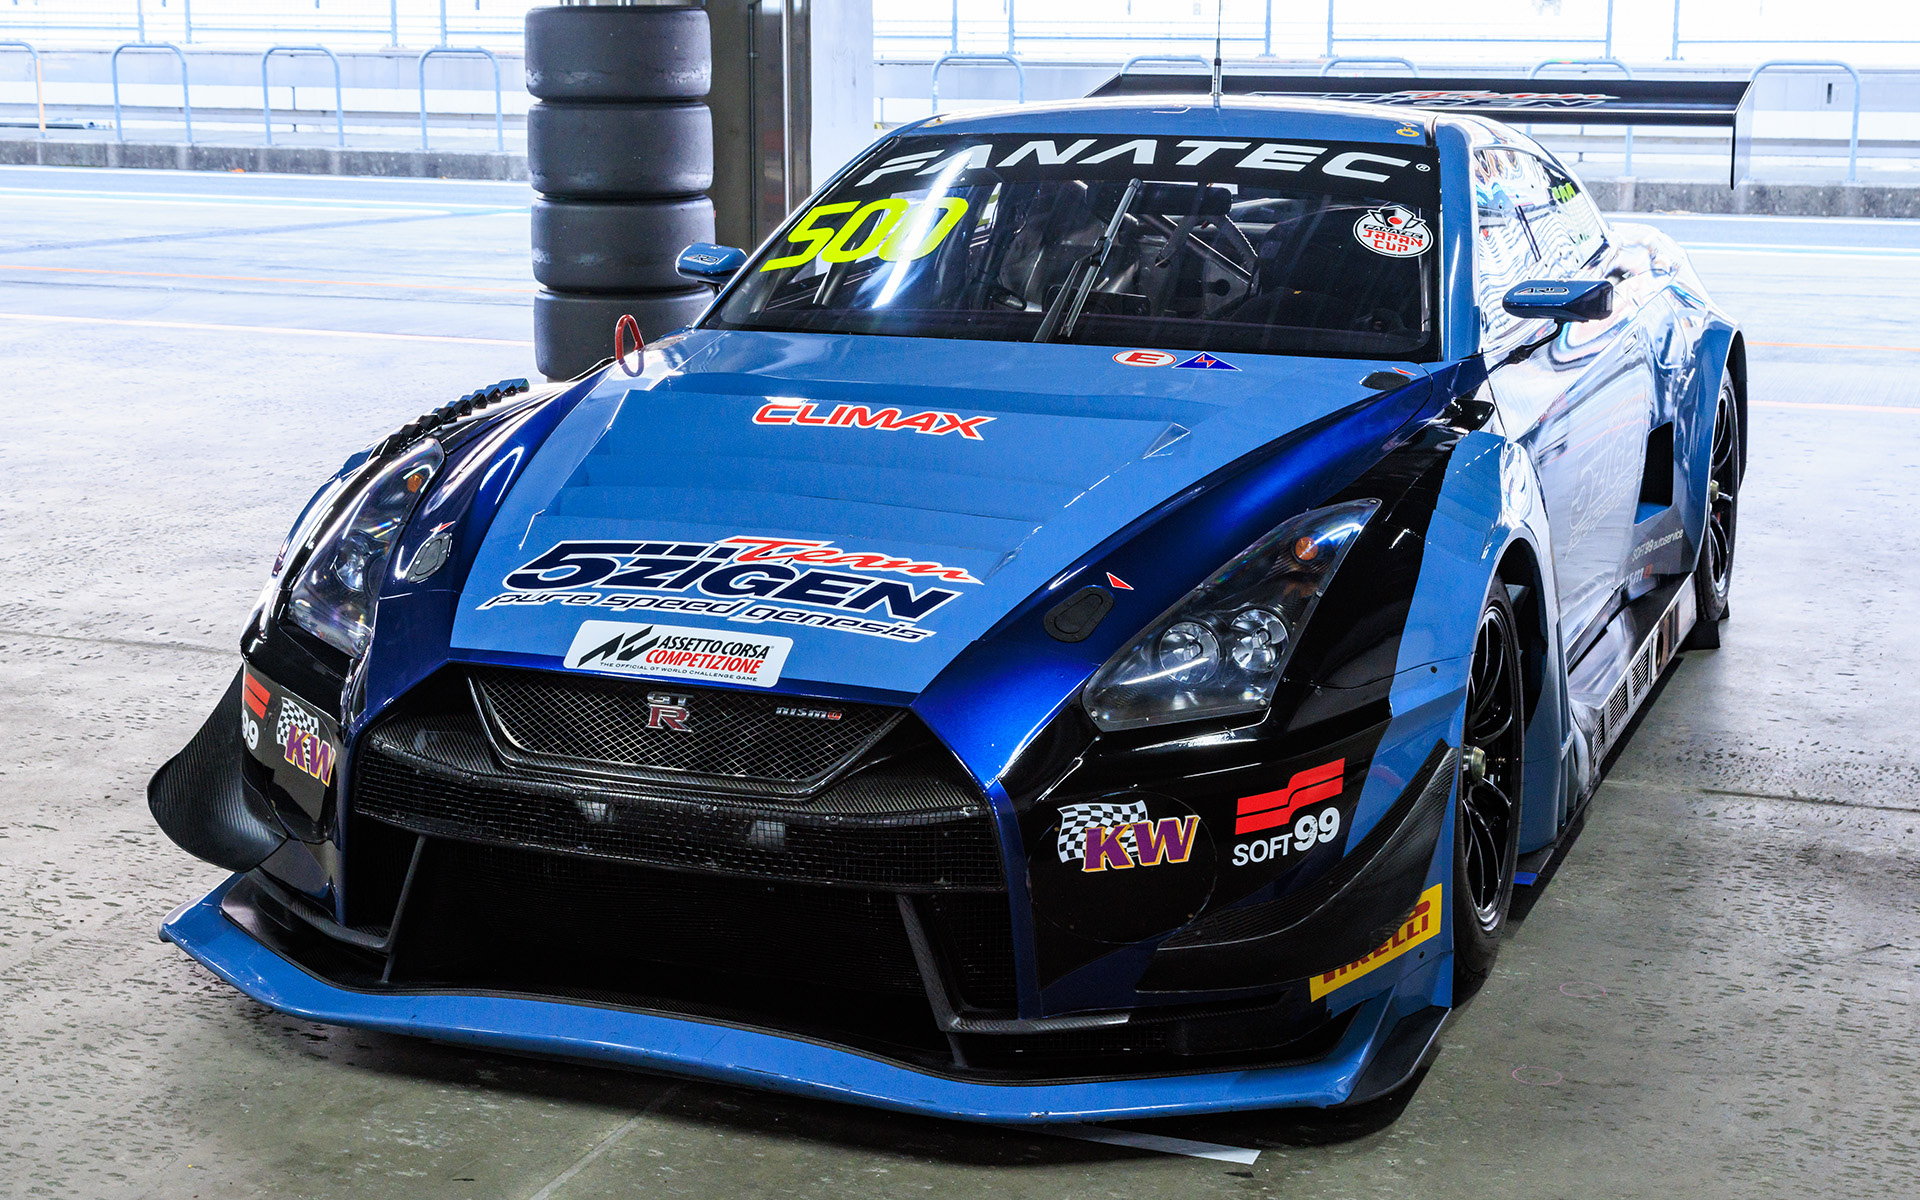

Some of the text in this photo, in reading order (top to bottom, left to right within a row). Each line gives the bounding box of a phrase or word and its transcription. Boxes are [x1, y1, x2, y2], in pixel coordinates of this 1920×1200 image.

[855, 139, 1411, 188] FANATEC
[759, 198, 968, 273] 500
[1363, 229, 1424, 248] JAPAN
[1373, 239, 1408, 252] CUP
[1124, 352, 1165, 365] E
[753, 402, 995, 440] CLIMAX
[715, 536, 984, 584] Team
[503, 540, 962, 620] 5ZIGEN
[480, 591, 936, 641] pure speed genesis
[645, 649, 764, 675] COMPETIZIONE
[658, 635, 771, 660] ASSETTO CORSA
[615, 663, 648, 671] OFFICIAL
[661, 667, 688, 675] WORLD
[689, 670, 734, 679] CHALLENGE
[736, 675, 759, 683] GAME
[647, 691, 694, 705] GT
[645, 704, 693, 733] R
[284, 722, 336, 787] KW
[1082, 815, 1201, 872] KW
[1323, 900, 1431, 985] ELLI
